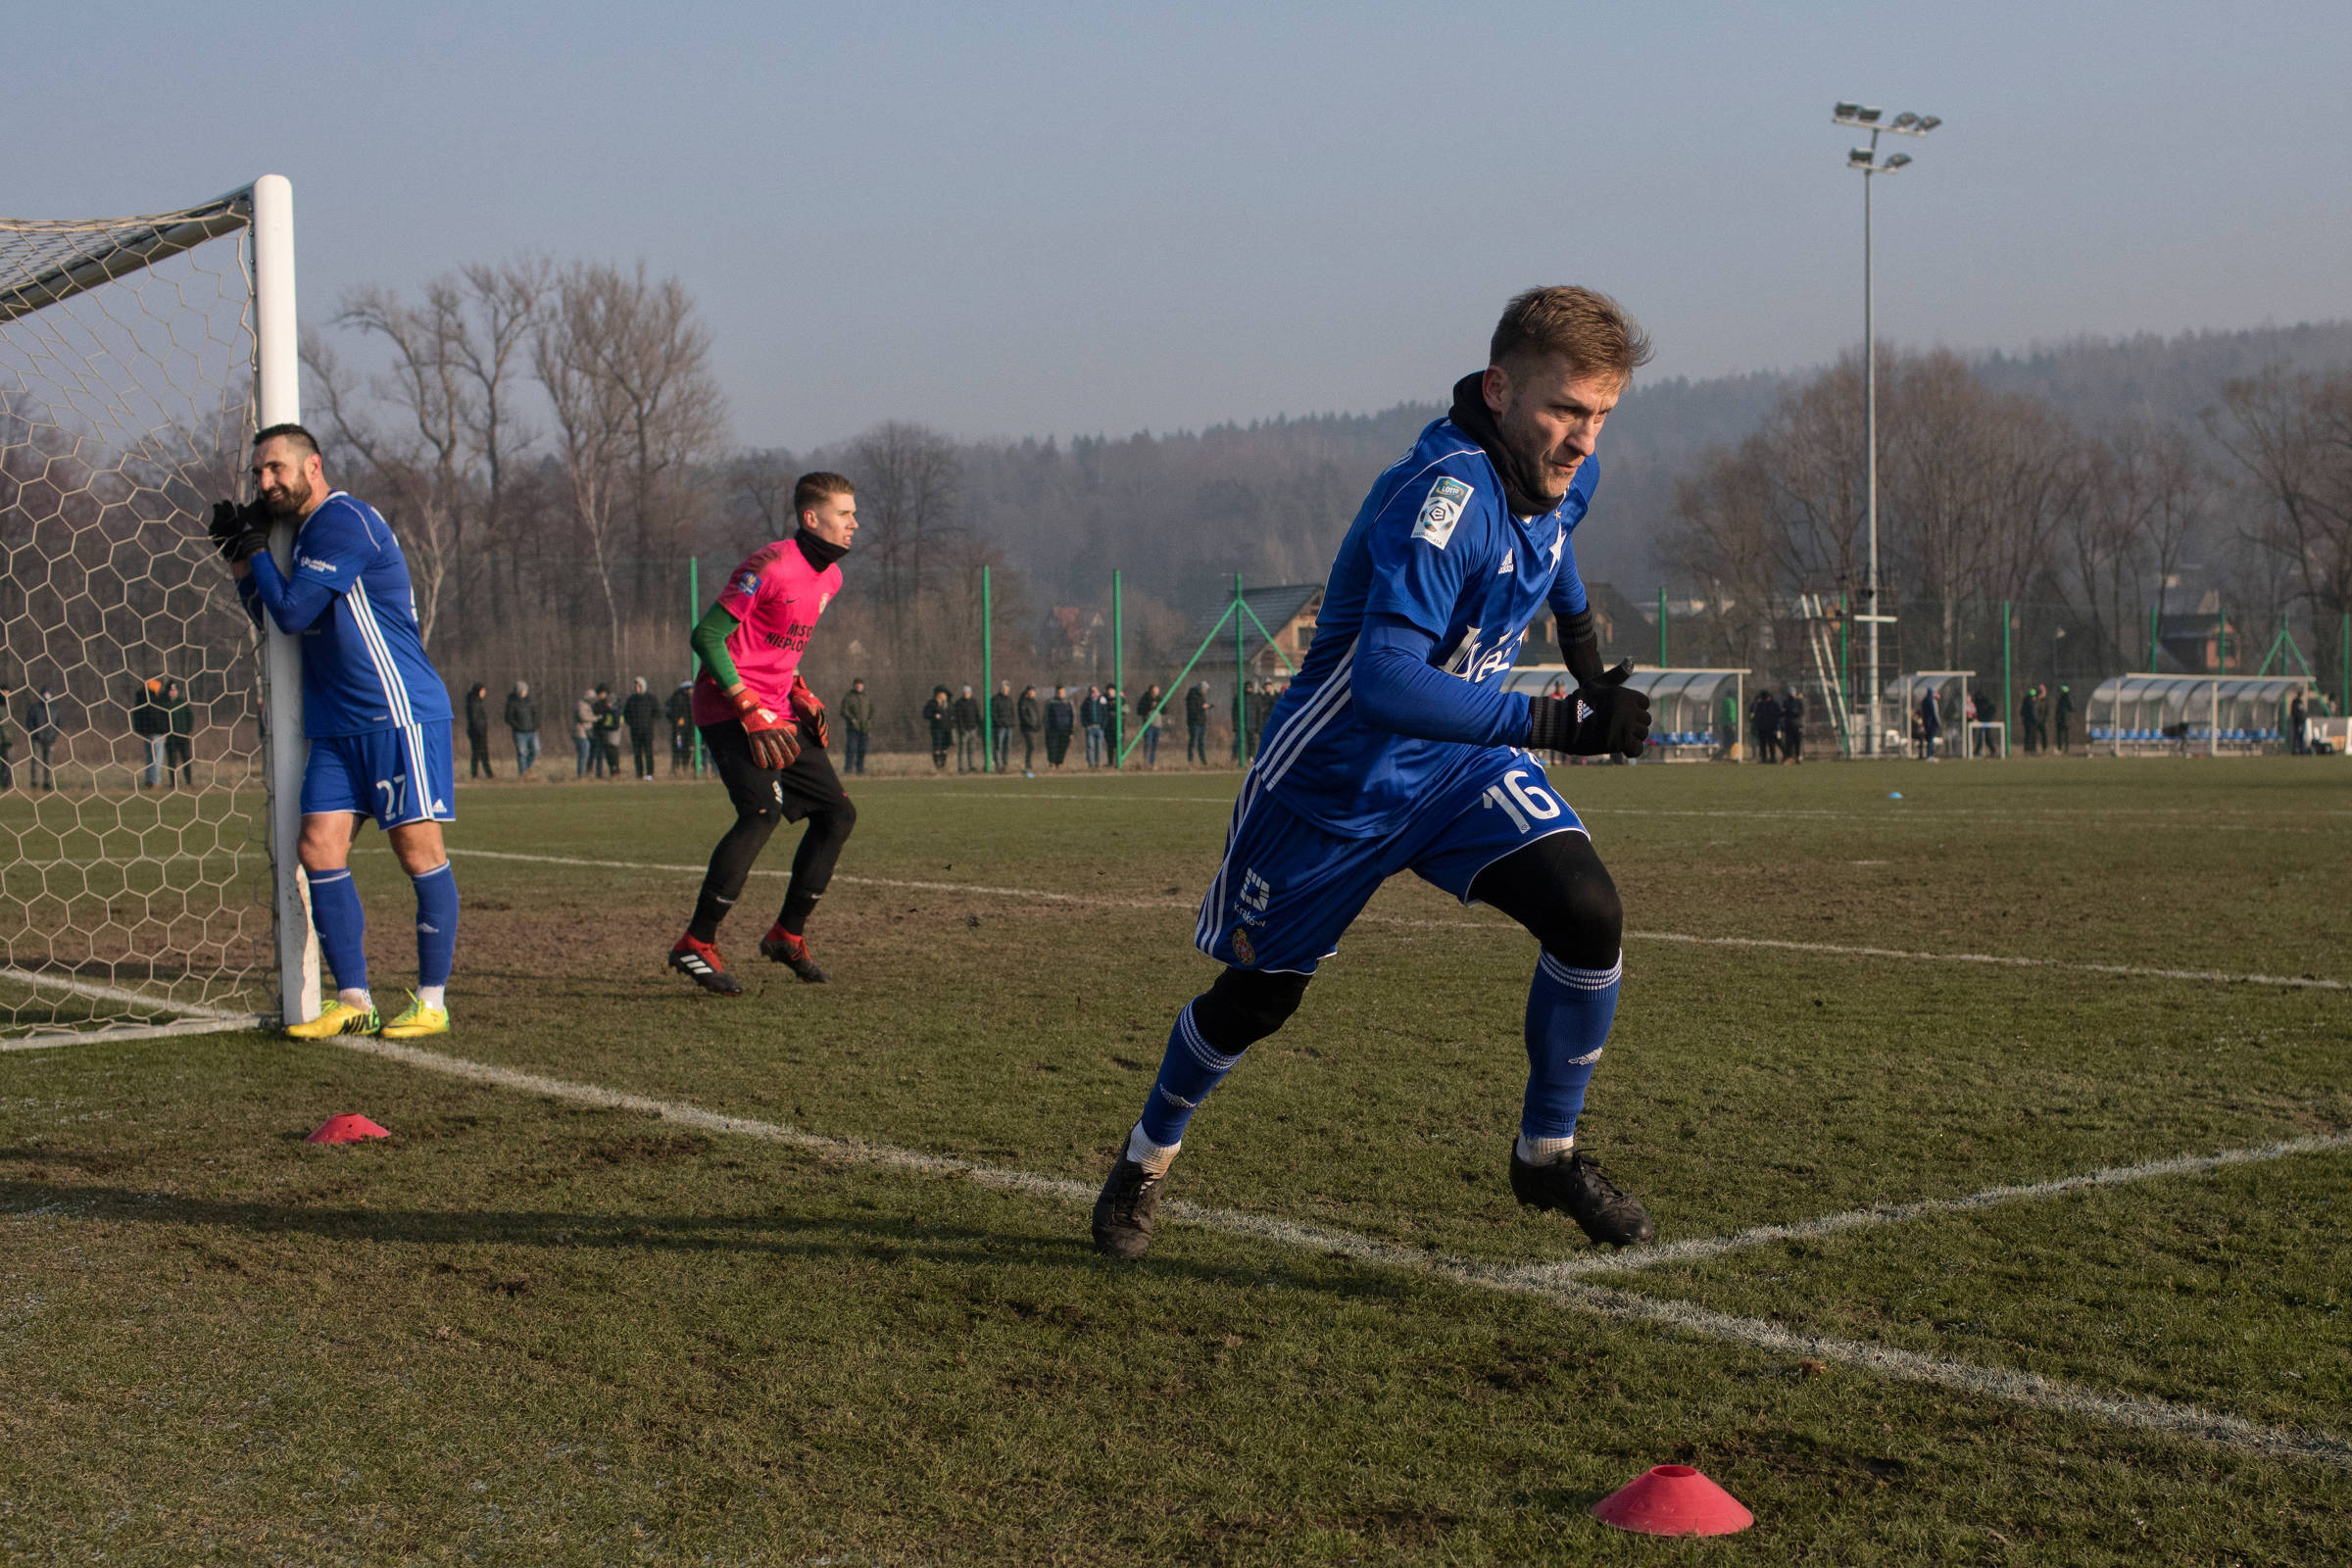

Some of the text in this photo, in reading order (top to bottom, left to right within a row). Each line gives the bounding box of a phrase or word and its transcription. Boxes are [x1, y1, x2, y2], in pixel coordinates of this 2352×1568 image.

[1441, 485, 1460, 495] LOTTO
[376, 774, 407, 821] 27
[1482, 769, 1561, 835] 16
